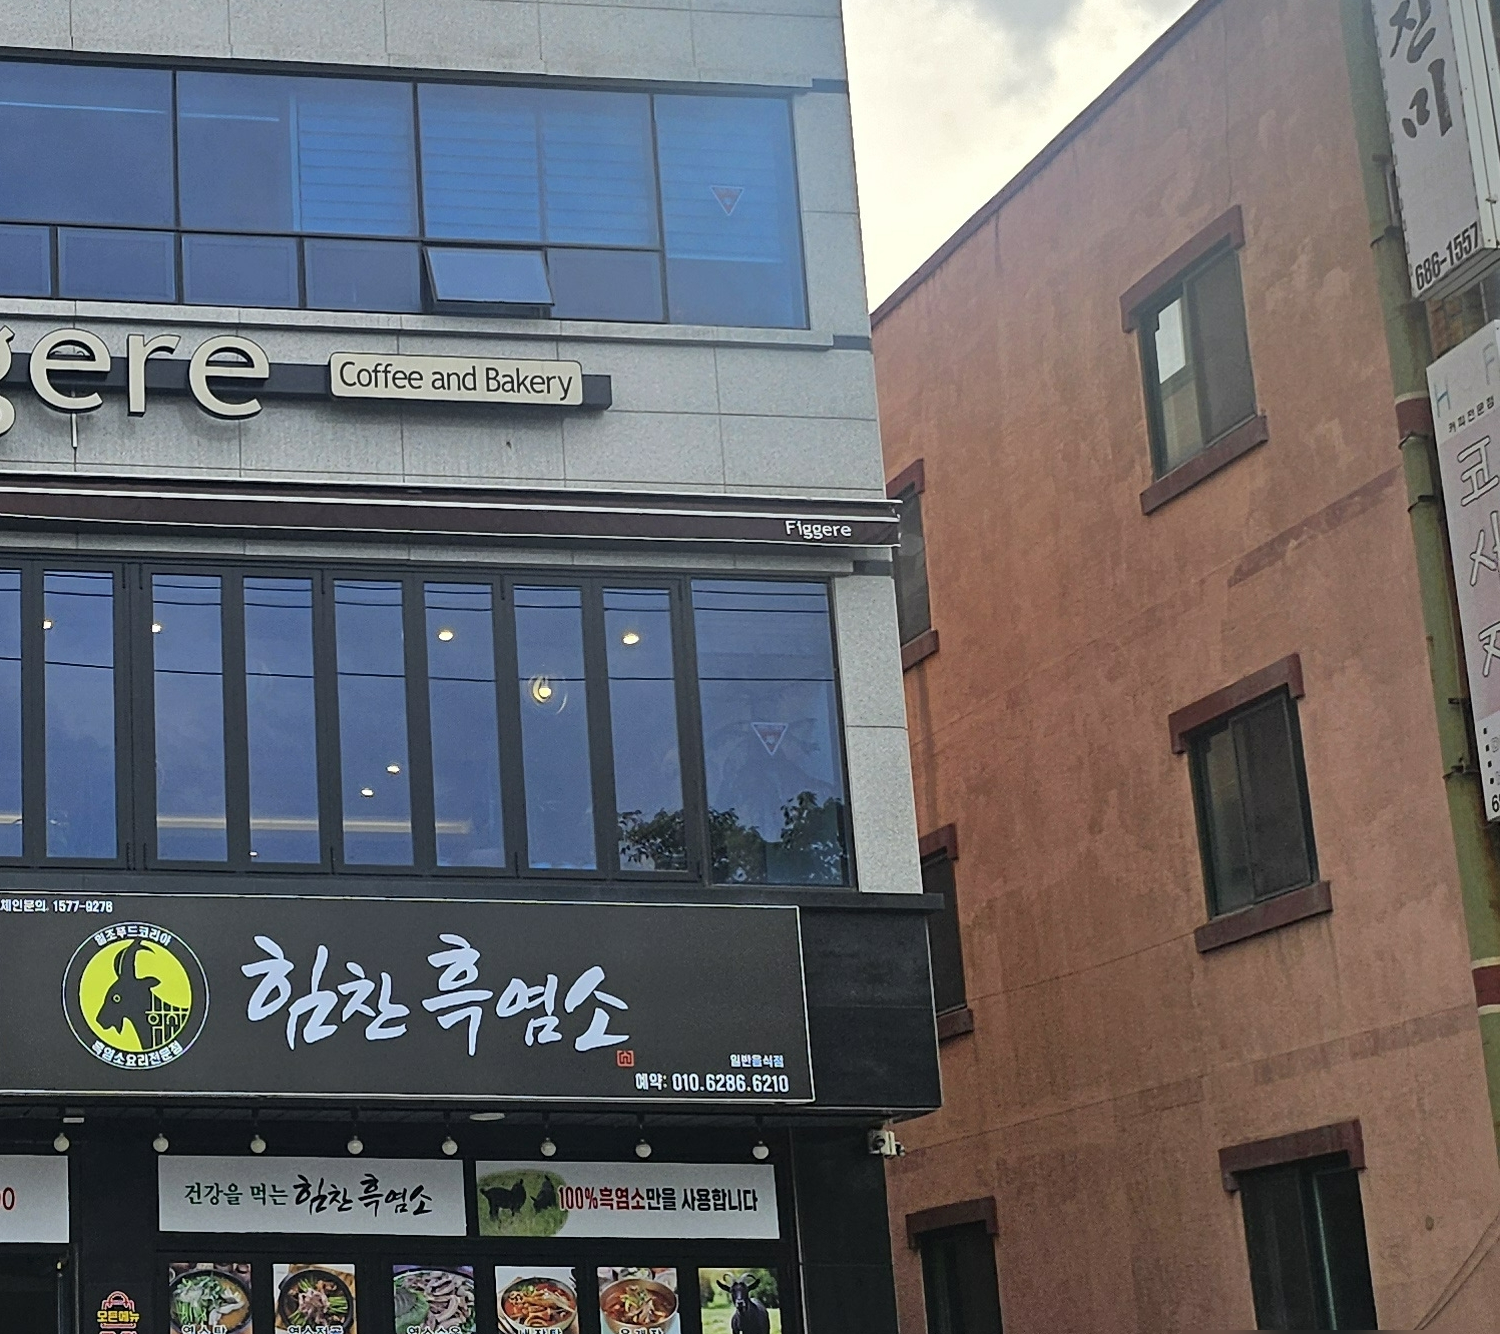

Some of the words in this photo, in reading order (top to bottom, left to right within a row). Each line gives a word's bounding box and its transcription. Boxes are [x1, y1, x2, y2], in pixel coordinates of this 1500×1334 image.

[1415, 222, 1480, 291] 686-1557
[339, 361, 424, 390] Coffee
[431, 365, 477, 391] and
[485, 367, 573, 401] Bakery
[784, 520, 852, 540] Figgere
[241, 934, 411, 1052] 힘찬
[421, 932, 631, 1057] 흑염소
[730, 1054, 785, 1068] 일반음식점
[634, 1073, 667, 1091] 예약:
[672, 1073, 790, 1093] 010.6286.6210
[184, 1182, 243, 1206] 건강을
[250, 1182, 289, 1206] 먹는
[293, 1174, 354, 1215] 힘찬
[358, 1173, 433, 1217] 흑염소
[681, 1188, 759, 1212] 사용합니다
[97, 1310, 140, 1323] 모든메뉴
